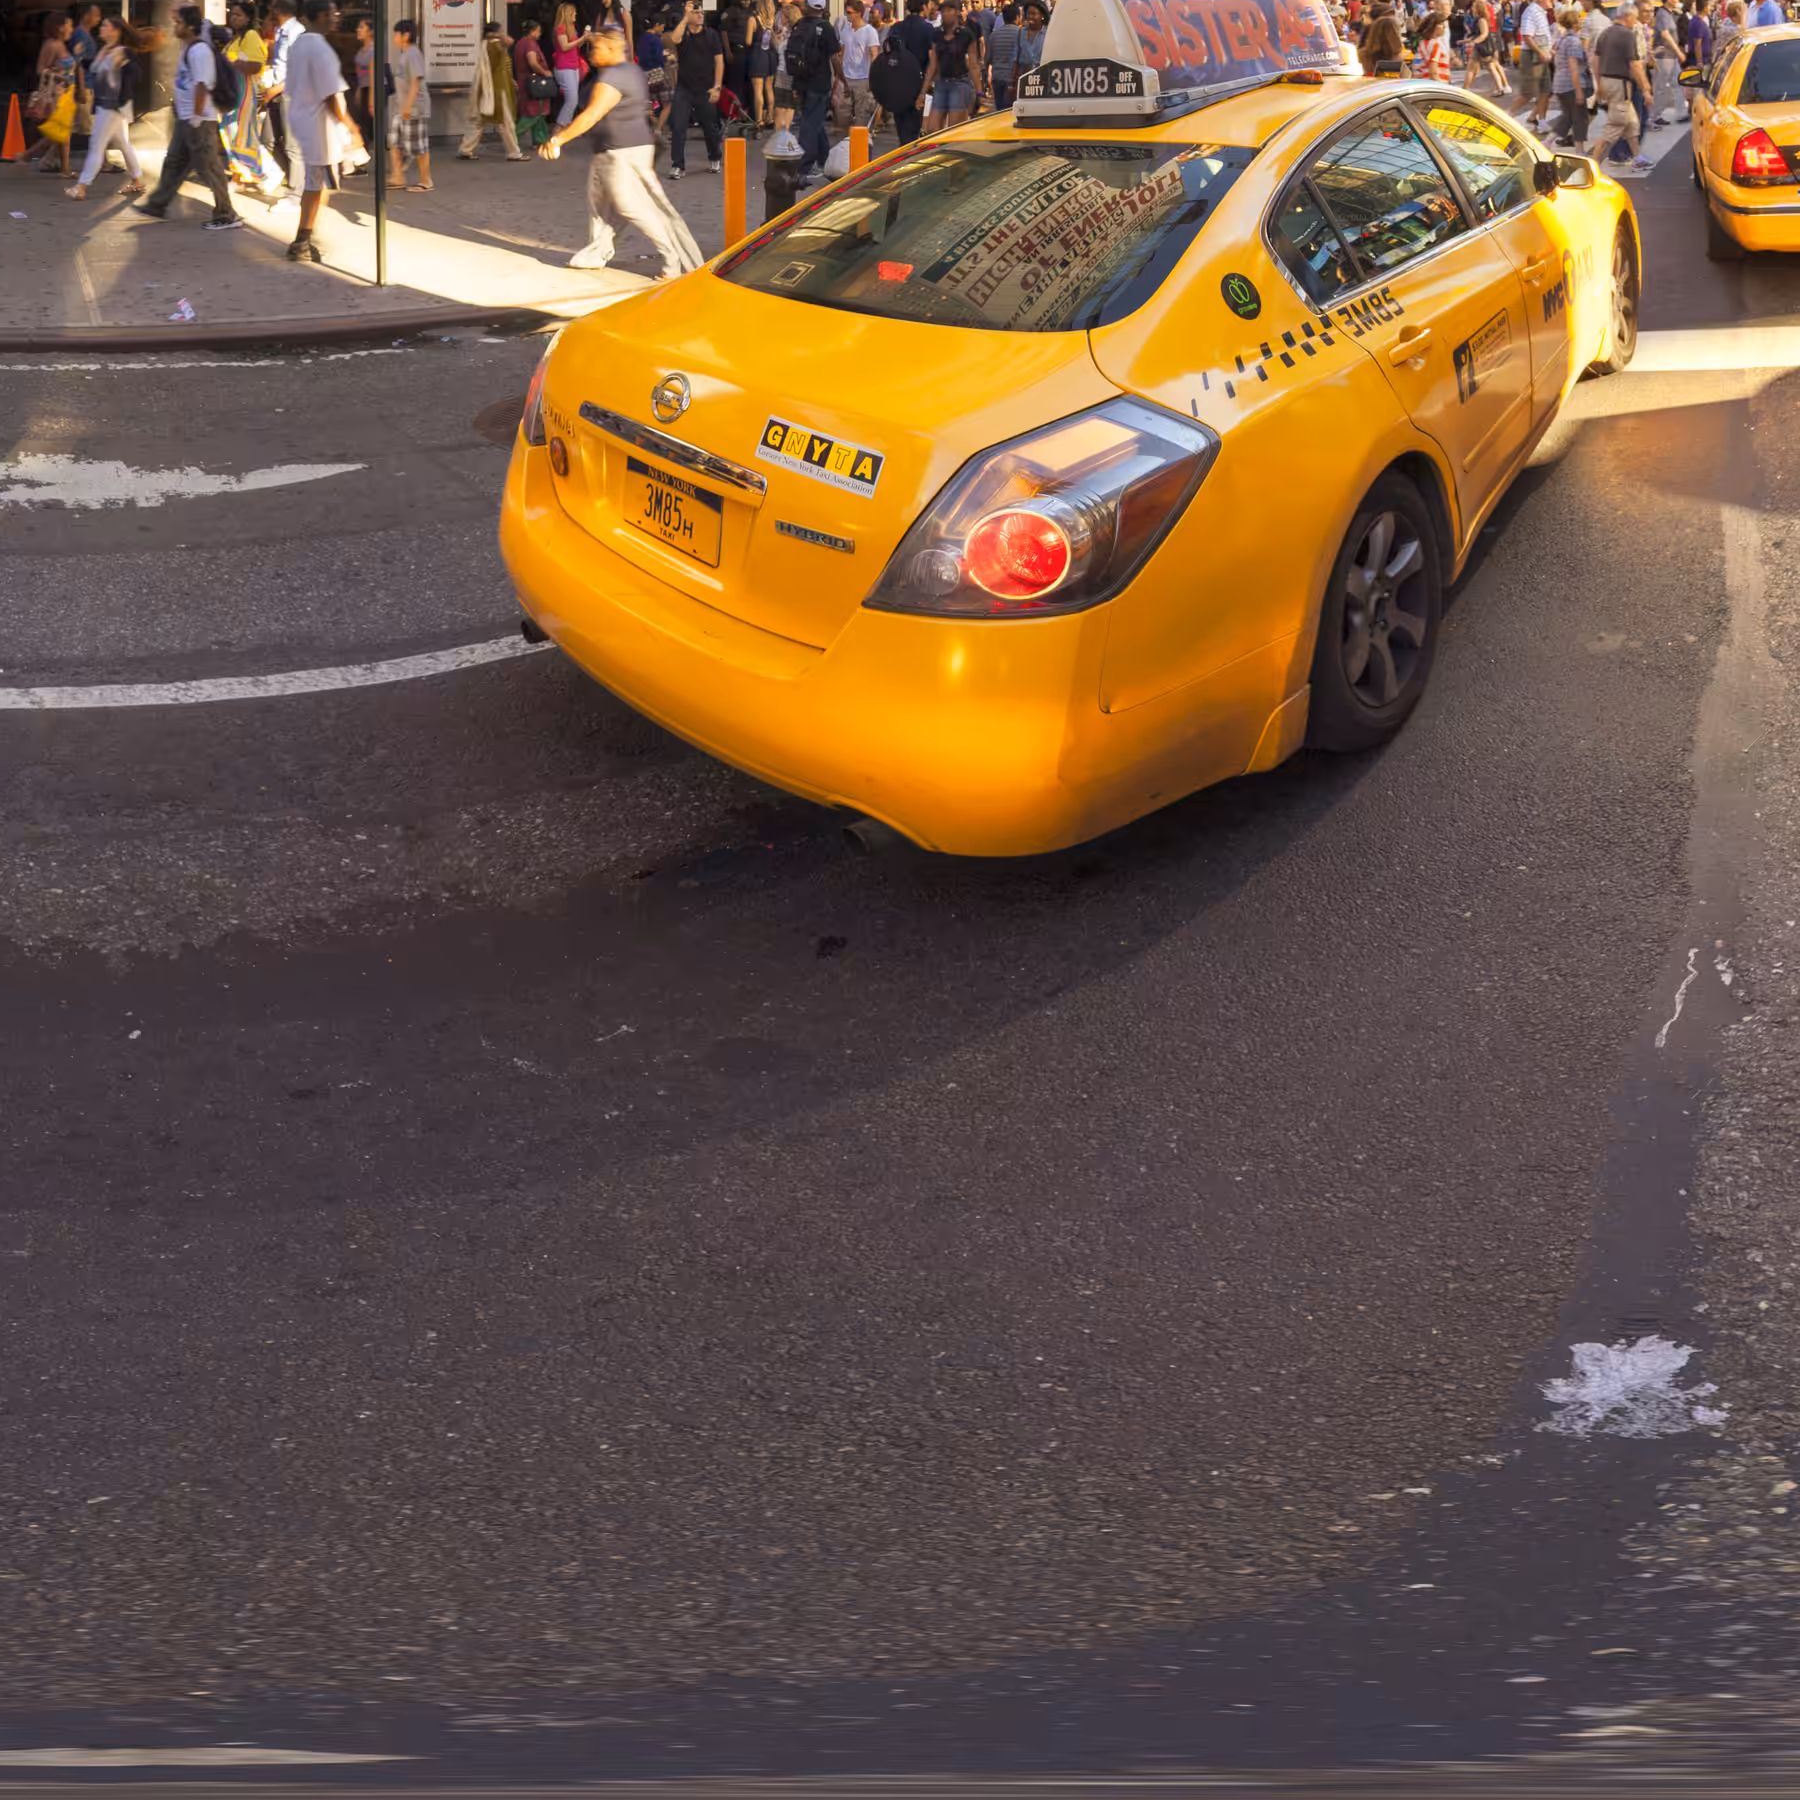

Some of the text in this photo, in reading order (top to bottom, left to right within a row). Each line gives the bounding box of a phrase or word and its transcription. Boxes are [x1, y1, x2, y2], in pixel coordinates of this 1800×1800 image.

[1051, 66, 1109, 95] 3M85
[1336, 286, 1406, 338] 3M85
[764, 422, 875, 482] GNYTA
[644, 483, 694, 539] 3M85 H
